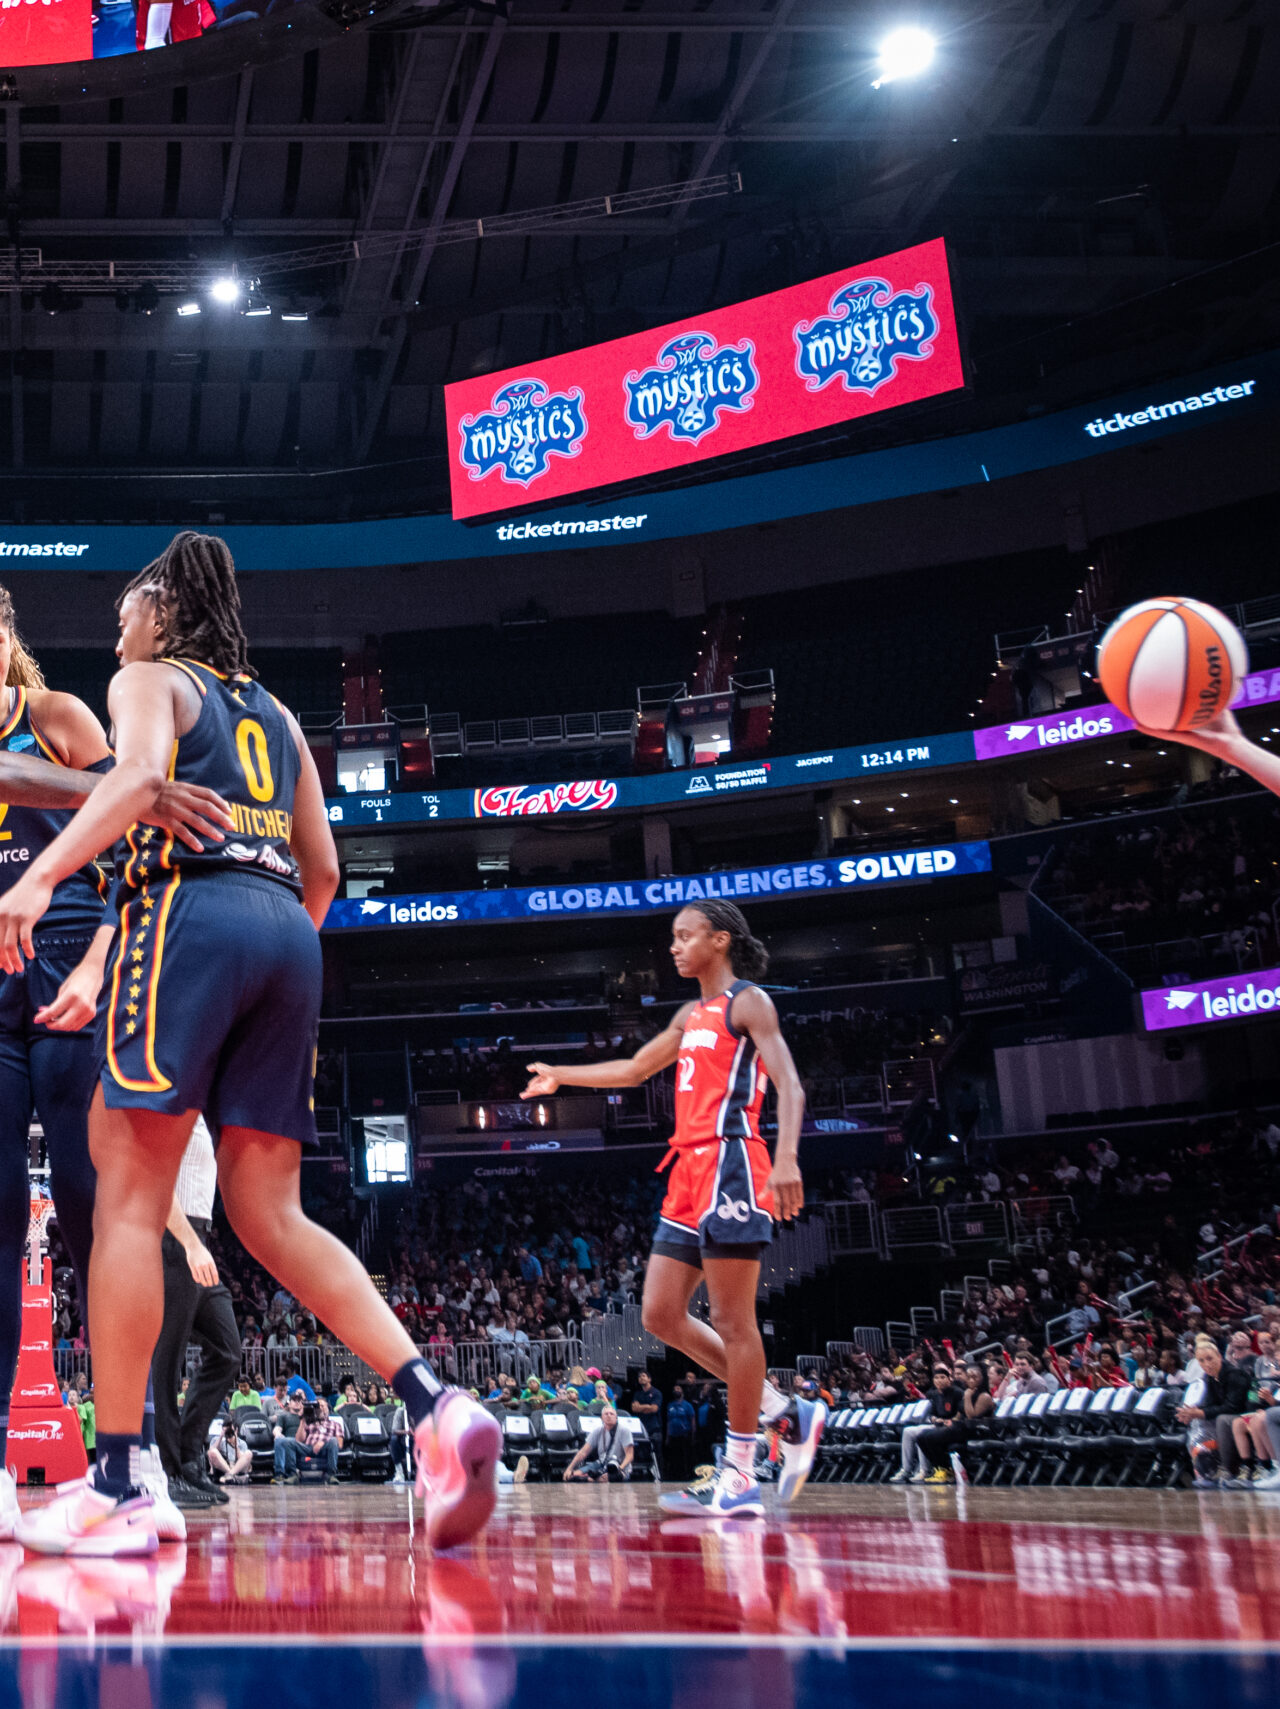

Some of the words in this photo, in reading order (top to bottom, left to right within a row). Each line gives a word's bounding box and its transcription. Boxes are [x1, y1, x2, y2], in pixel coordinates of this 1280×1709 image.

[1084, 380, 1256, 437] ticketmaster
[496, 514, 648, 541] ticketmaster
[1037, 716, 1113, 746] leidos
[235, 719, 275, 803] 0
[795, 755, 833, 767] JACKPOT
[860, 750, 904, 767] 12:14
[907, 746, 930, 761] PM
[715, 768, 766, 781] FOUNDATION
[740, 776, 767, 787] RAFFLE
[361, 798, 391, 809] FOULS
[422, 795, 440, 804] TOL
[481, 780, 618, 817] Fever
[376, 809, 383, 821] 1
[429, 805, 438, 818] 2
[389, 901, 458, 923] leidos
[528, 884, 639, 913] GLOBAL
[645, 864, 833, 903] CHALLENGES,
[839, 850, 957, 883] SOLVED
[966, 1223, 982, 1235] EXIT
